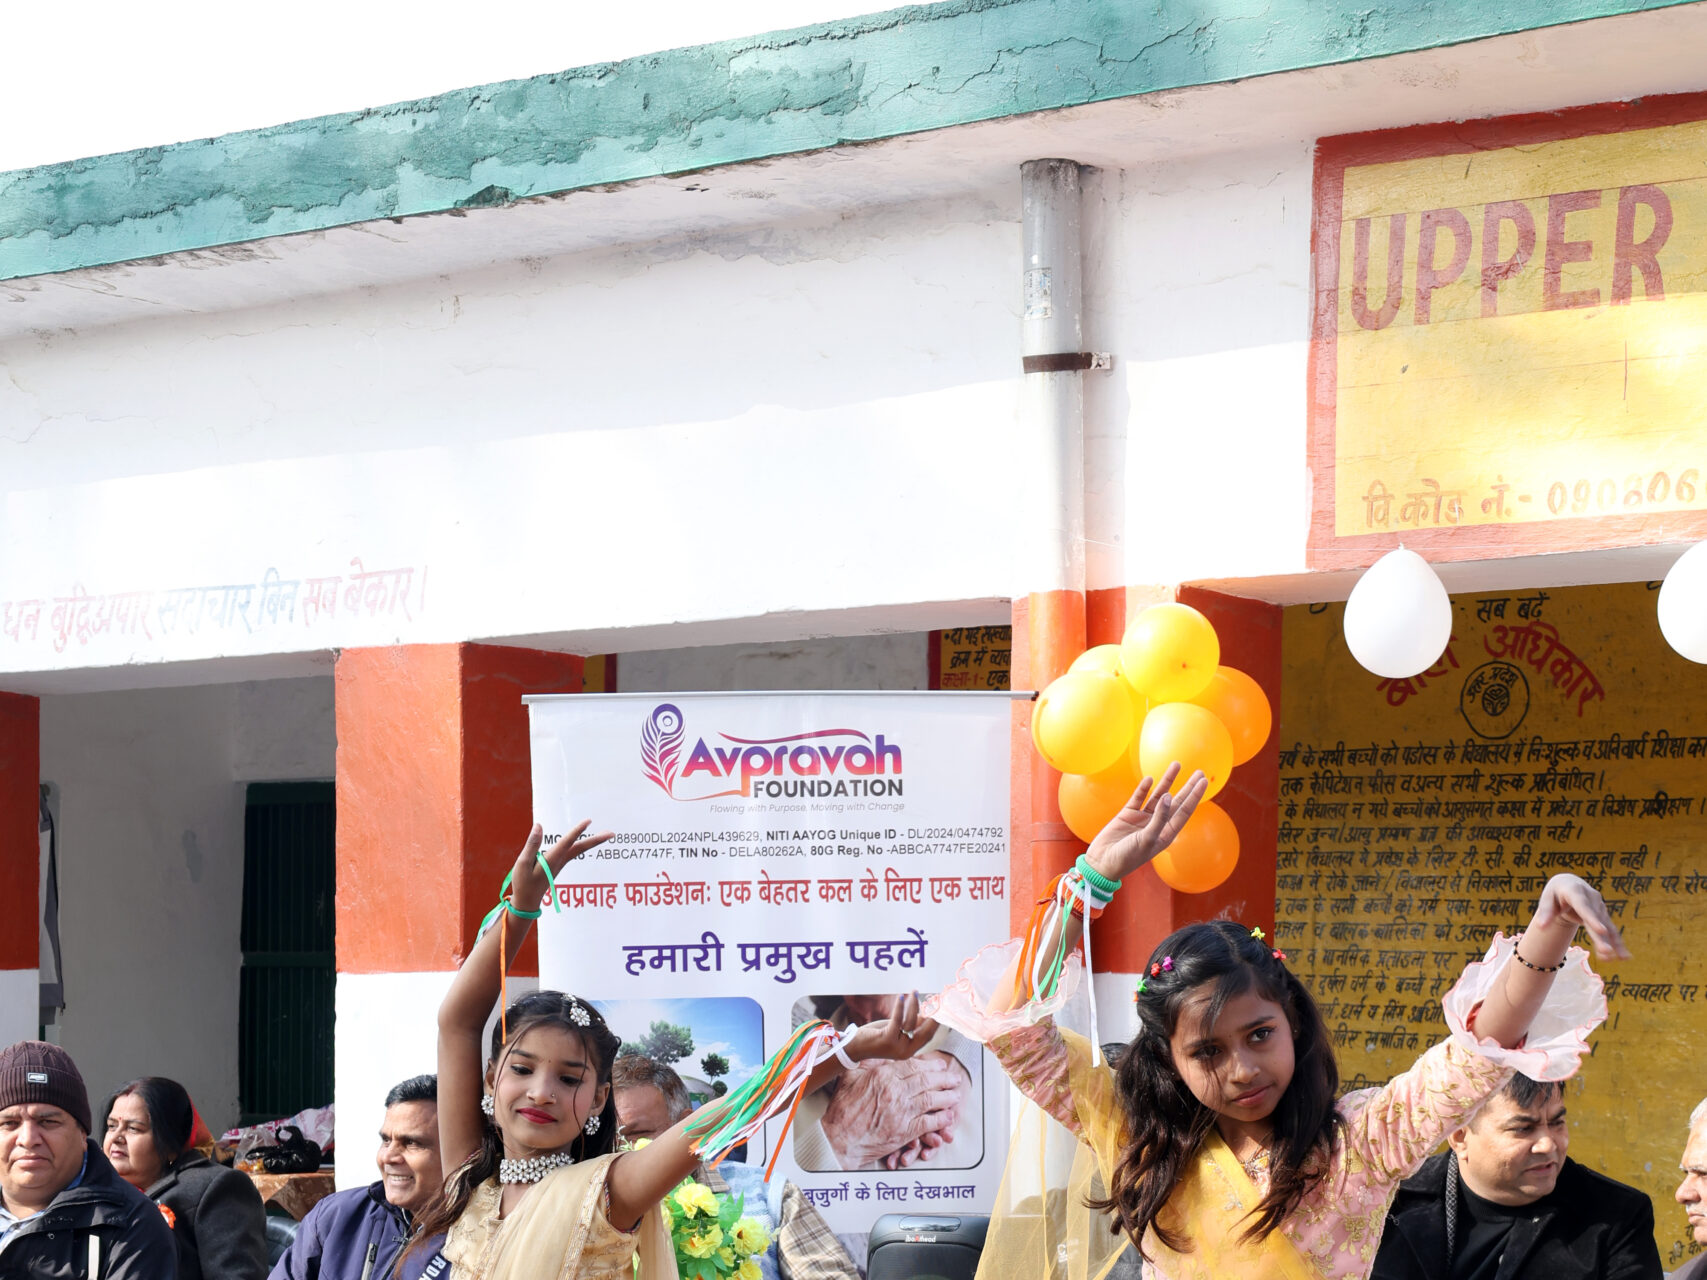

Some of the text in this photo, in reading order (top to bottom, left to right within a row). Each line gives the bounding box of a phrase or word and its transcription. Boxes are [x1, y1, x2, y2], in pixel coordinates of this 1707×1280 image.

[1350, 183, 1674, 331] UPPER
[157, 584, 256, 635] सदाचार
[258, 567, 301, 625] बिन
[302, 576, 342, 628] सब
[1477, 598, 1511, 623] सब
[1484, 621, 1605, 717] अधिकार
[1302, 745, 1319, 767] के
[1318, 741, 1348, 769] सभी
[1380, 740, 1400, 766] को
[1444, 739, 1460, 764] के
[1650, 729, 1688, 759] शिक्षा
[680, 735, 903, 797] Avpravah
[754, 779, 903, 798] FOUNDATION
[1280, 777, 1304, 796] तक
[1367, 769, 1398, 795] फीस
[1450, 768, 1484, 795] सभी
[710, 805, 745, 816] Flowing
[748, 804, 767, 813] with
[810, 803, 844, 814] Moving
[847, 803, 866, 812] with
[868, 802, 905, 813] Change
[1285, 799, 1299, 820] के
[1352, 802, 1366, 820] न
[1531, 795, 1545, 818] में
[1586, 800, 1600, 818] व
[766, 830, 790, 842] NITI
[792, 829, 836, 841] AAYOG
[840, 829, 881, 842] Unique
[884, 828, 897, 840] ID
[907, 827, 1003, 839] DL/2024/0474792
[596, 848, 675, 861] ABBCA7747F,
[679, 848, 699, 858] TIN
[701, 847, 718, 858] No
[810, 845, 834, 856] 80G
[837, 844, 864, 857] Reg.
[867, 844, 883, 855] No
[1512, 844, 1532, 868] की
[718, 880, 752, 907] एक
[757, 869, 811, 907] बेहतर
[817, 878, 853, 904] कल
[859, 868, 878, 902] के
[884, 867, 923, 904] लिए
[929, 877, 962, 904] एक
[968, 875, 1006, 900] साथ
[1661, 874, 1682, 894] पर
[622, 927, 928, 984] हमारी प्रमुख पहलें
[1679, 984, 1700, 1003] पर
[854, 1182, 870, 1201] के
[876, 1181, 908, 1201] लिए
[914, 1180, 976, 1200] देखभाल
